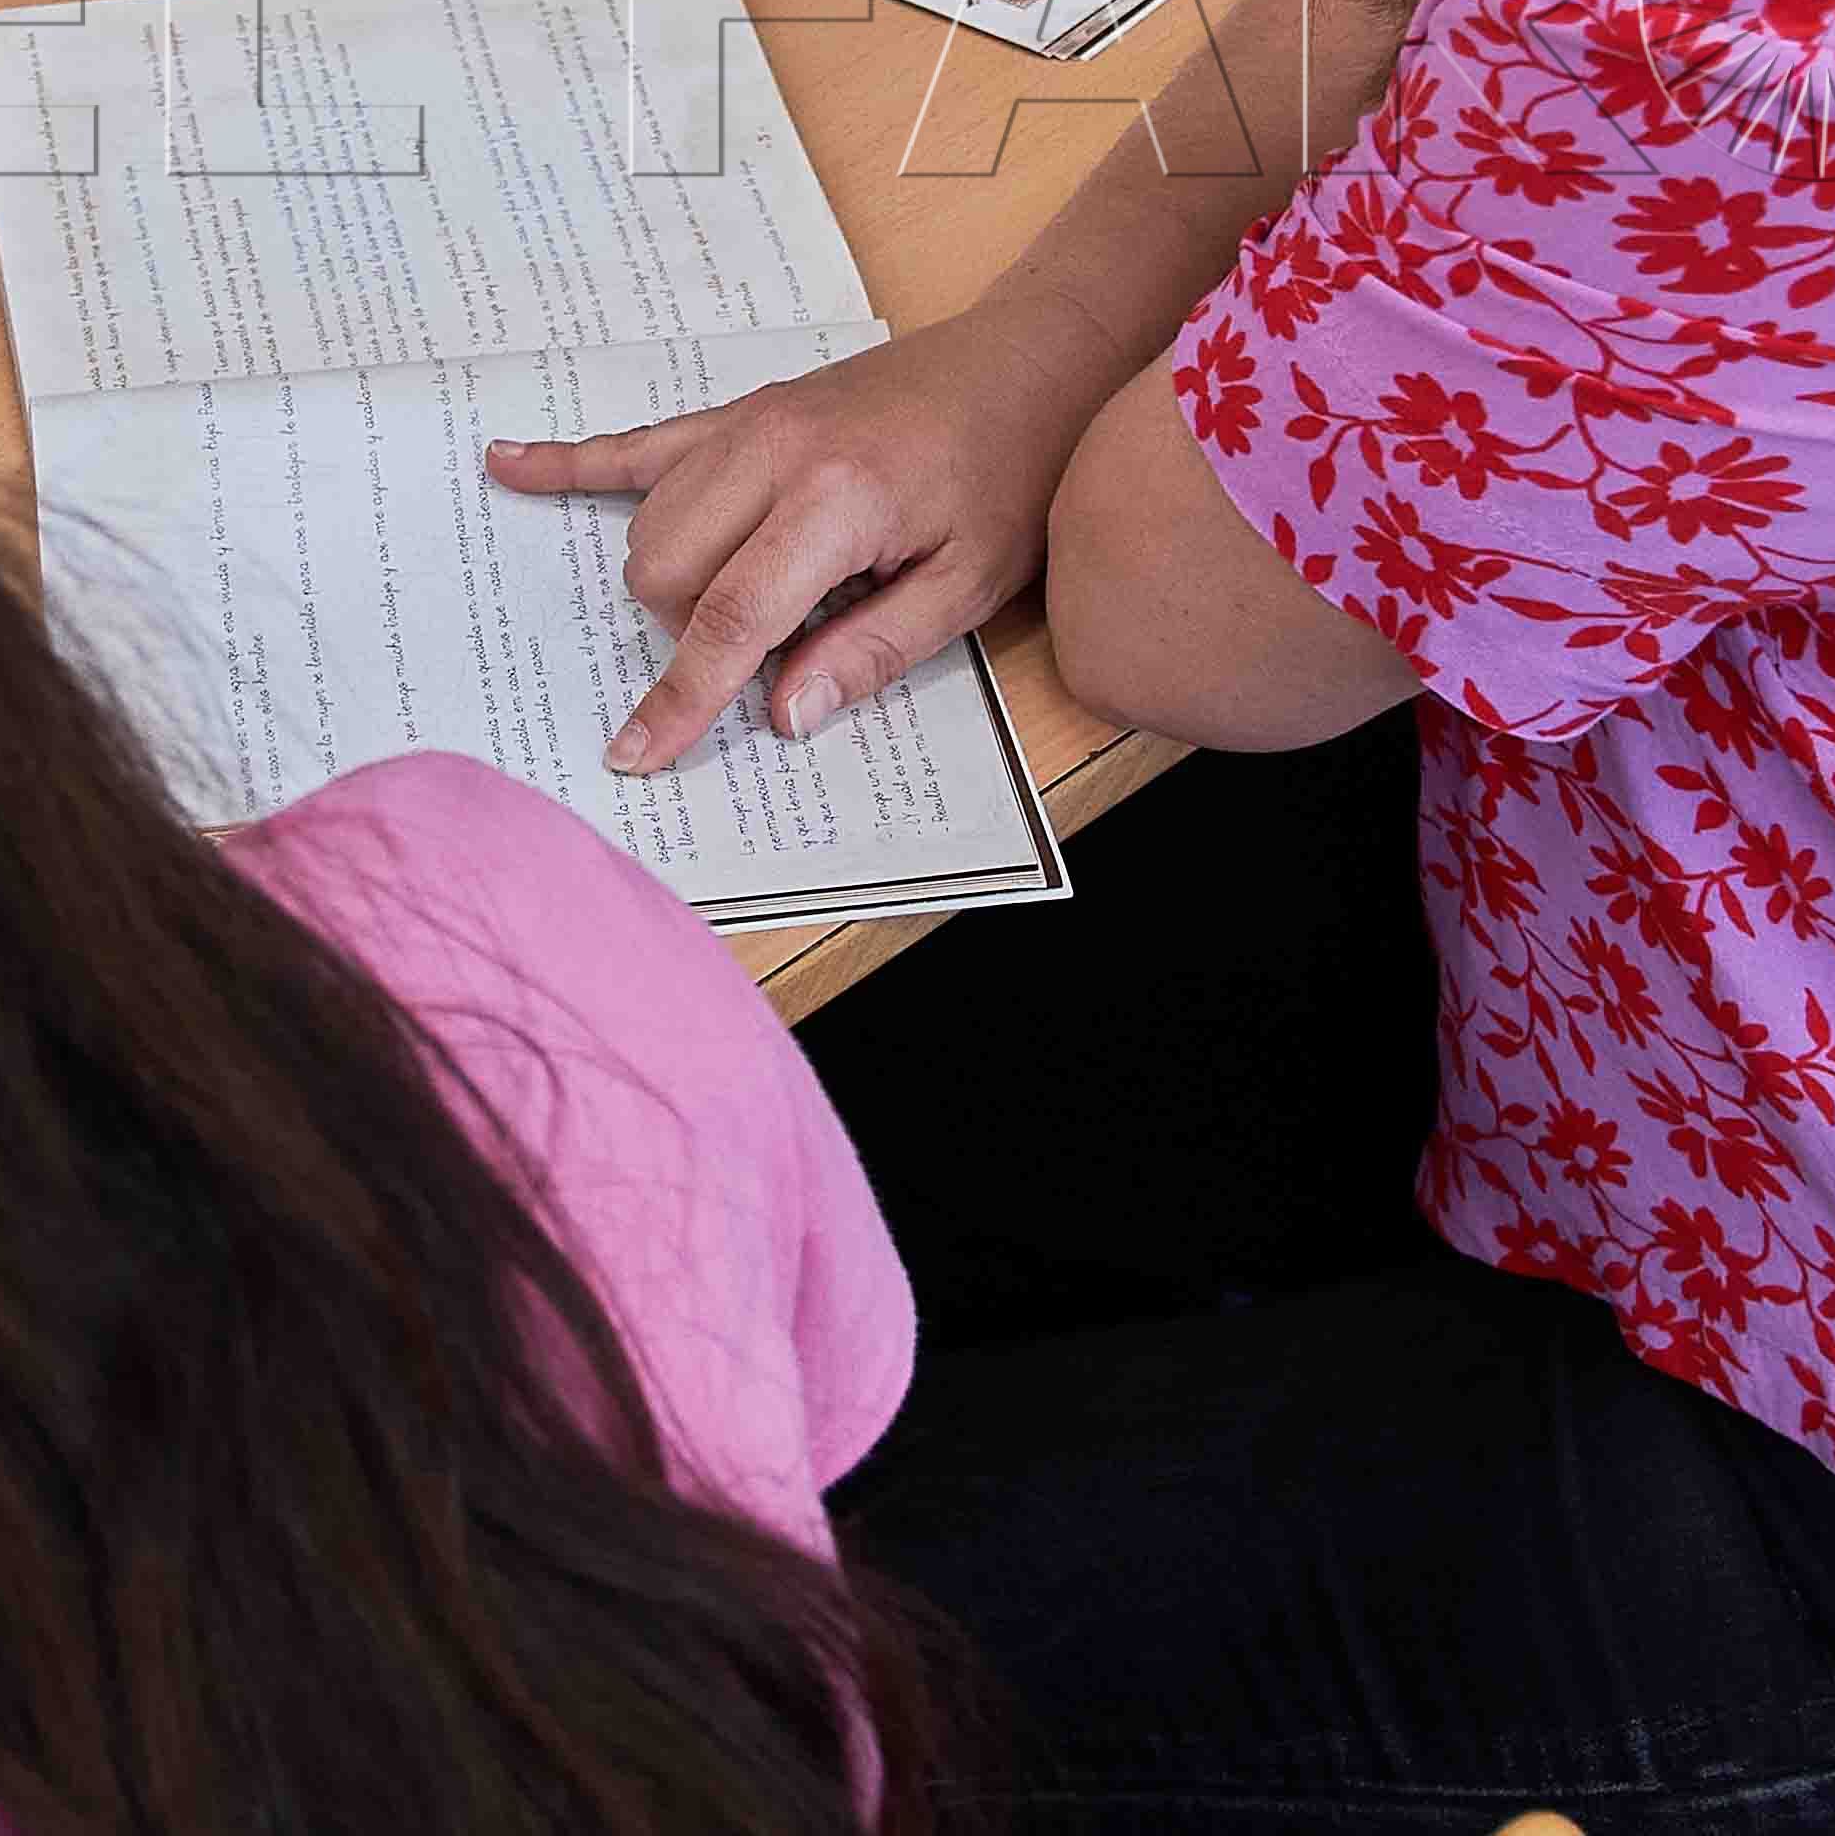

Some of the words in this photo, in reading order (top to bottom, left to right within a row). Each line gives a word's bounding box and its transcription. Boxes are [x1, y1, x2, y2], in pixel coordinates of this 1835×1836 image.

[431, 371, 449, 385] la
[691, 339, 714, 395] ayudara
[435, 388, 452, 407] de
[461, 363, 481, 403] mujer
[647, 379, 661, 411] casa
[201, 422, 224, 451] hija
[278, 421, 297, 436] le
[443, 409, 456, 446] cosas
[209, 456, 221, 491] una
[284, 441, 306, 505] trabajar
[443, 449, 459, 473] las
[364, 450, 389, 506] ayudas
[374, 512, 386, 537] me
[450, 477, 473, 565] preparando
[217, 547, 234, 557] y
[584, 504, 612, 574] sospechara
[383, 567, 399, 577] y
[560, 539, 581, 581] vuelto
[213, 563, 232, 605] viuda
[299, 561, 314, 596] para
[462, 568, 477, 597] casa
[484, 561, 504, 597] nada
[379, 581, 401, 628] trabajo
[467, 601, 480, 620] en
[495, 605, 512, 628] que
[598, 601, 617, 627] ella
[223, 611, 235, 634] era
[299, 601, 322, 668] levantaba
[225, 638, 240, 663] que
[384, 632, 405, 678] mucho
[466, 624, 491, 674] quedaba
[500, 631, 513, 659] sino
[528, 636, 546, 676] pasear
[609, 631, 629, 652] que
[247, 634, 268, 685] hombre
[588, 659, 603, 687] casa
[614, 654, 637, 684] para
[313, 672, 324, 684] se
[481, 677, 492, 689] se
[507, 666, 520, 692] casa
[232, 699, 245, 727] una
[259, 688, 273, 715] otro
[315, 689, 335, 728] mujer
[396, 681, 417, 717] tengo
[483, 693, 499, 715] que
[512, 695, 524, 714] en
[899, 683, 917, 729] marido
[403, 720, 419, 743] que
[534, 693, 558, 753] marchaba
[849, 707, 880, 764] problema
[315, 733, 333, 747] la
[511, 718, 541, 765] quedaba
[774, 742, 800, 774] fama
[894, 764, 906, 777] es
[920, 755, 937, 777] que
[632, 772, 657, 808] burro
[668, 776, 685, 803] toda
[811, 771, 827, 799] una
[867, 768, 881, 788] un
[613, 803, 631, 816] la
[731, 797, 753, 835] mujer
[819, 802, 837, 824] que
[873, 791, 893, 829] Tengo
[923, 781, 948, 823] Resulta
[642, 812, 661, 823] el
[676, 805, 695, 846] llevase
[793, 815, 813, 837] que
[652, 826, 675, 864] dejado
[742, 839, 757, 855] La
